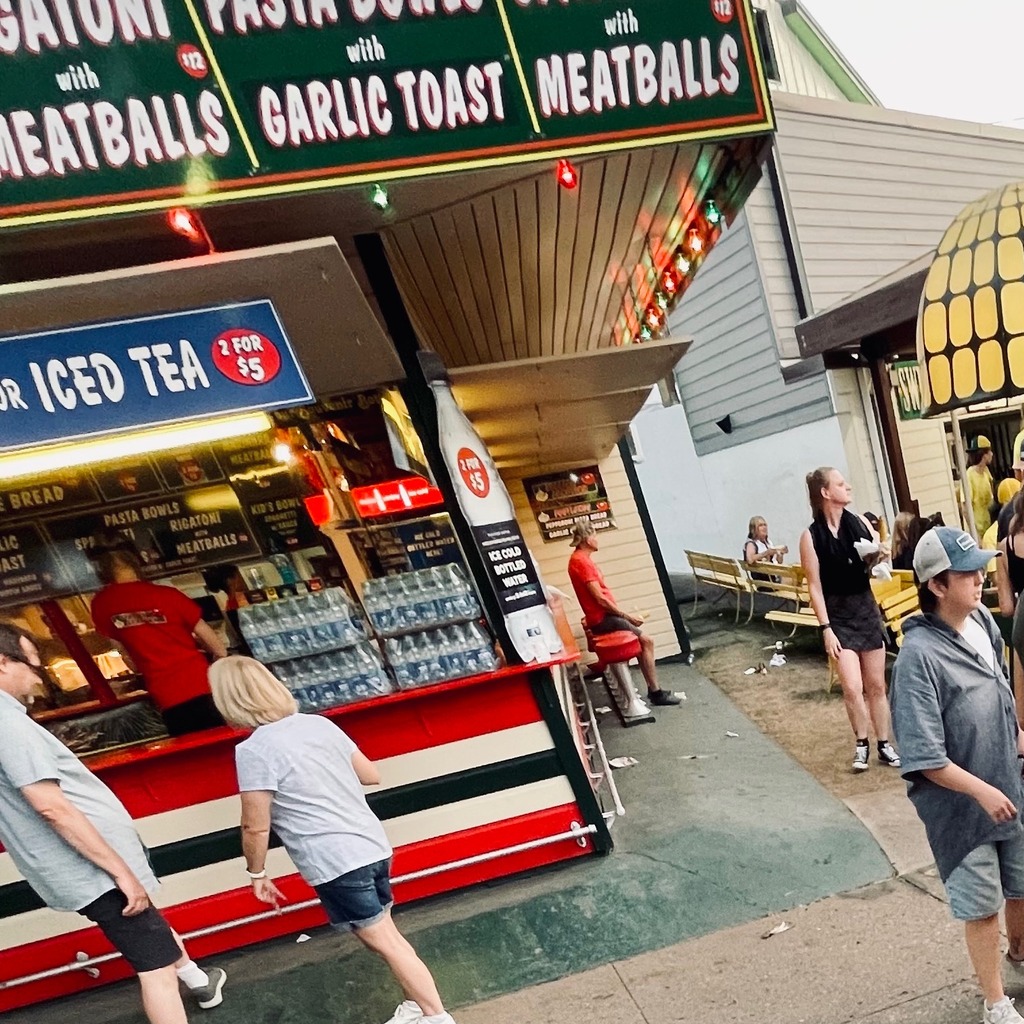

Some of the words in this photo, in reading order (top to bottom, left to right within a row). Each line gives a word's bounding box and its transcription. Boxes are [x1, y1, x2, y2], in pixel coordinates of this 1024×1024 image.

[603, 8, 640, 36] with
[346, 34, 386, 63] with
[55, 61, 100, 91] with
[535, 33, 740, 118] MEATBALLS
[258, 75, 393, 147] GARLIC
[394, 61, 505, 131] TOAST
[218, 339, 229, 357] 2
[231, 334, 265, 354] FOR
[28, 352, 125, 413] ICED
[127, 339, 211, 397] TEA
[236, 355, 266, 382] $5
[460, 459, 468, 471] 2
[465, 457, 481, 471] FOR
[470, 471, 485, 491] $5
[9, 485, 64, 510] BREAD
[104, 510, 140, 528] PASTA
[141, 501, 180, 520] BOWLS
[169, 511, 222, 532] RIGATONI
[177, 533, 238, 555] MEATBALLS
[488, 549, 503, 562] ICE
[501, 546, 522, 560] COLD
[493, 559, 527, 576] BOTTLED
[502, 573, 529, 588] WATER
